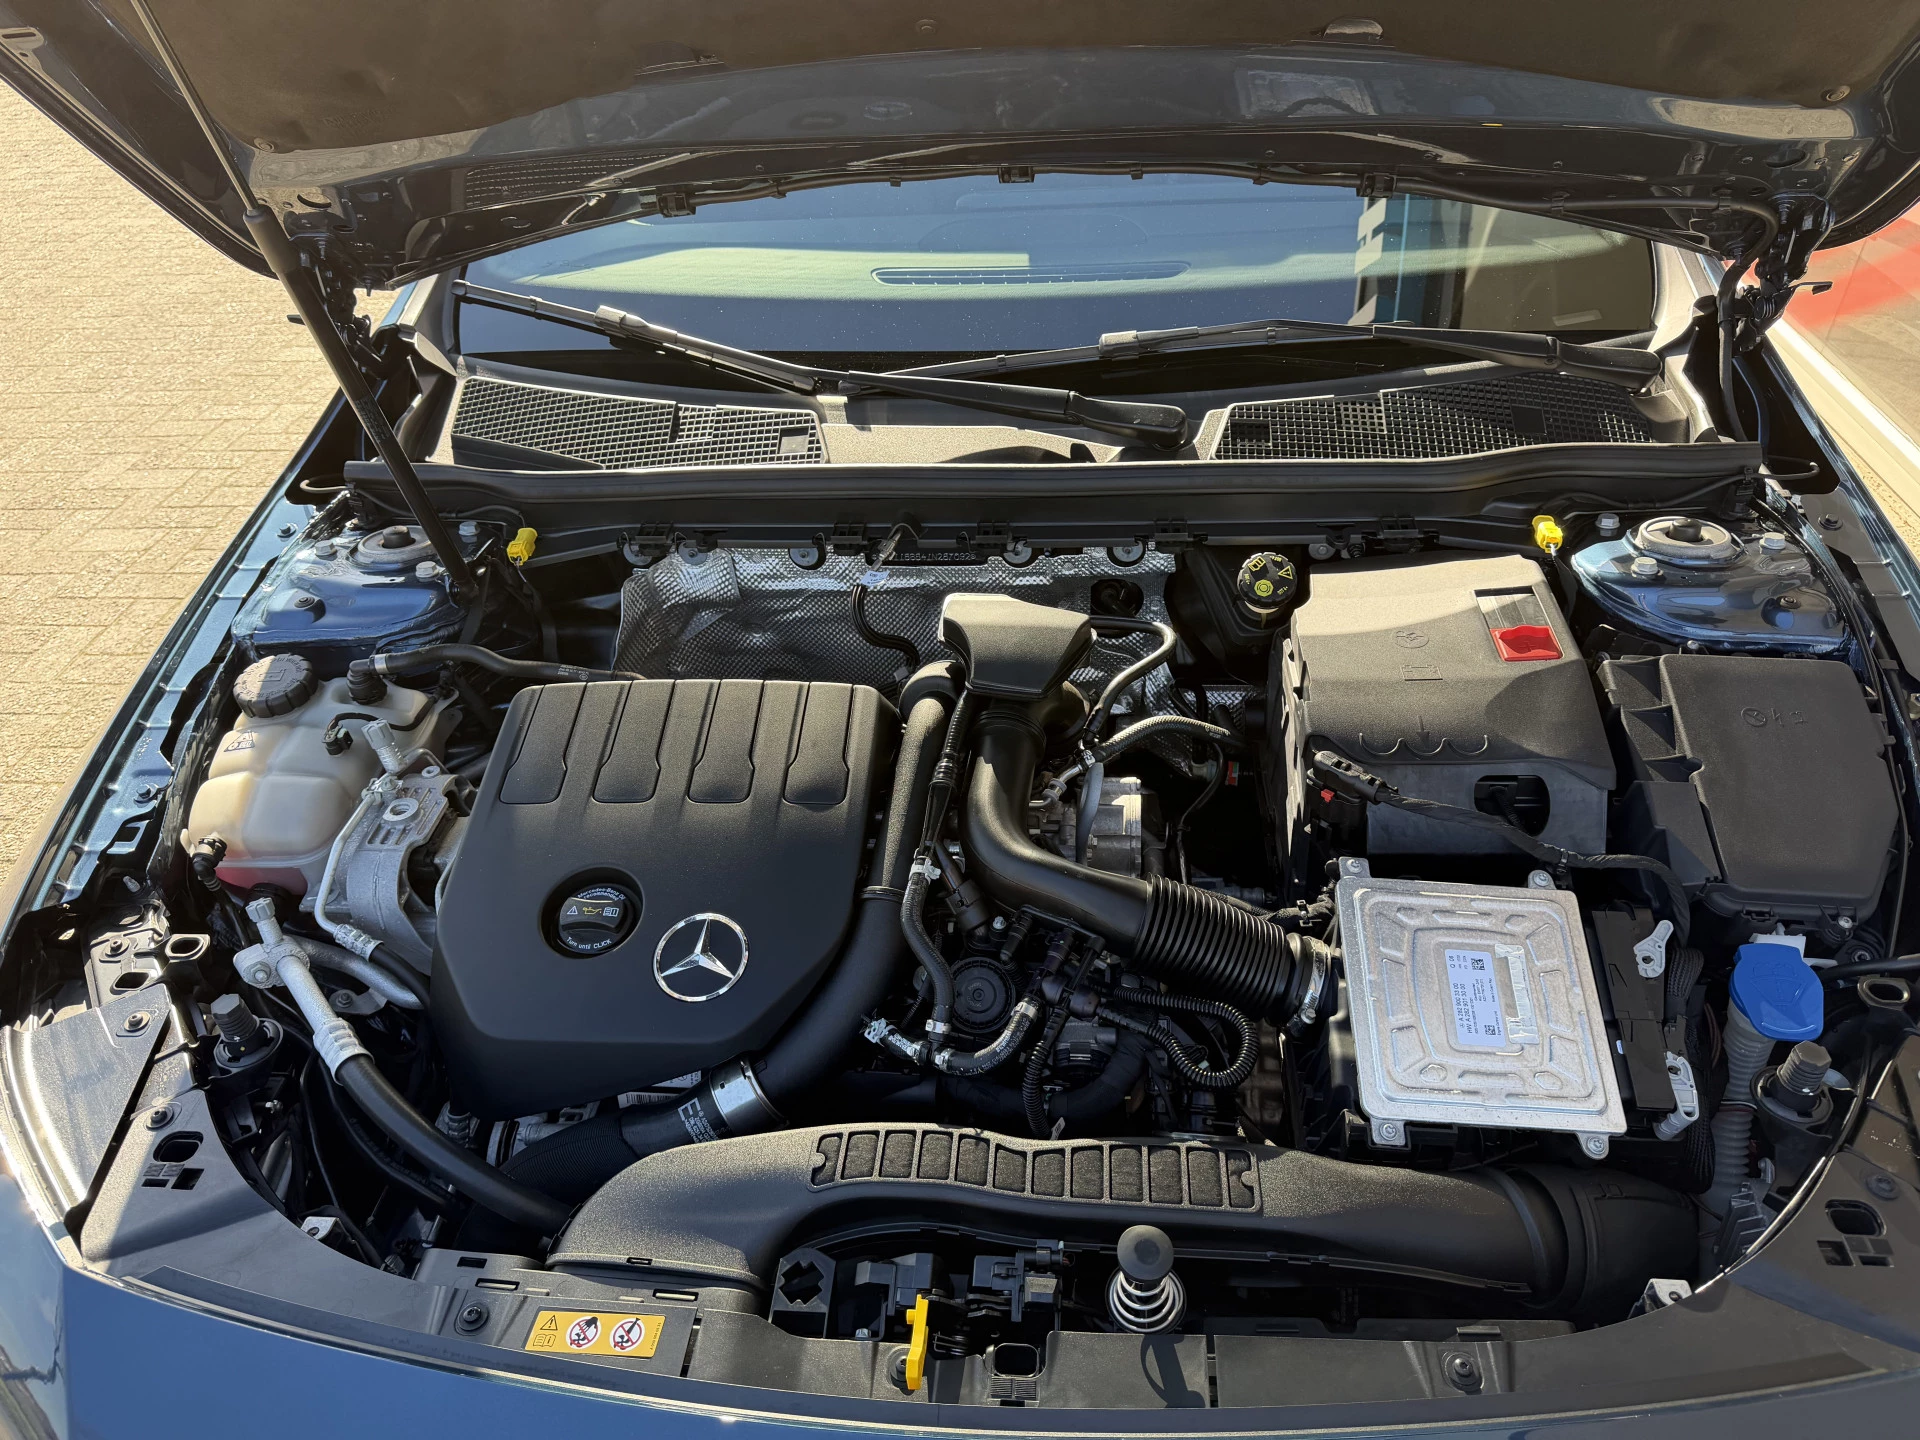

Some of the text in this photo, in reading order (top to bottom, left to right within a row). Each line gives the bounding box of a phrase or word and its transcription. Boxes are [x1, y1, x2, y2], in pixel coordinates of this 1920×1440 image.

[567, 937, 577, 947] Turn
[593, 939, 612, 948] CLICK
[1466, 1023, 1473, 1033] HW
